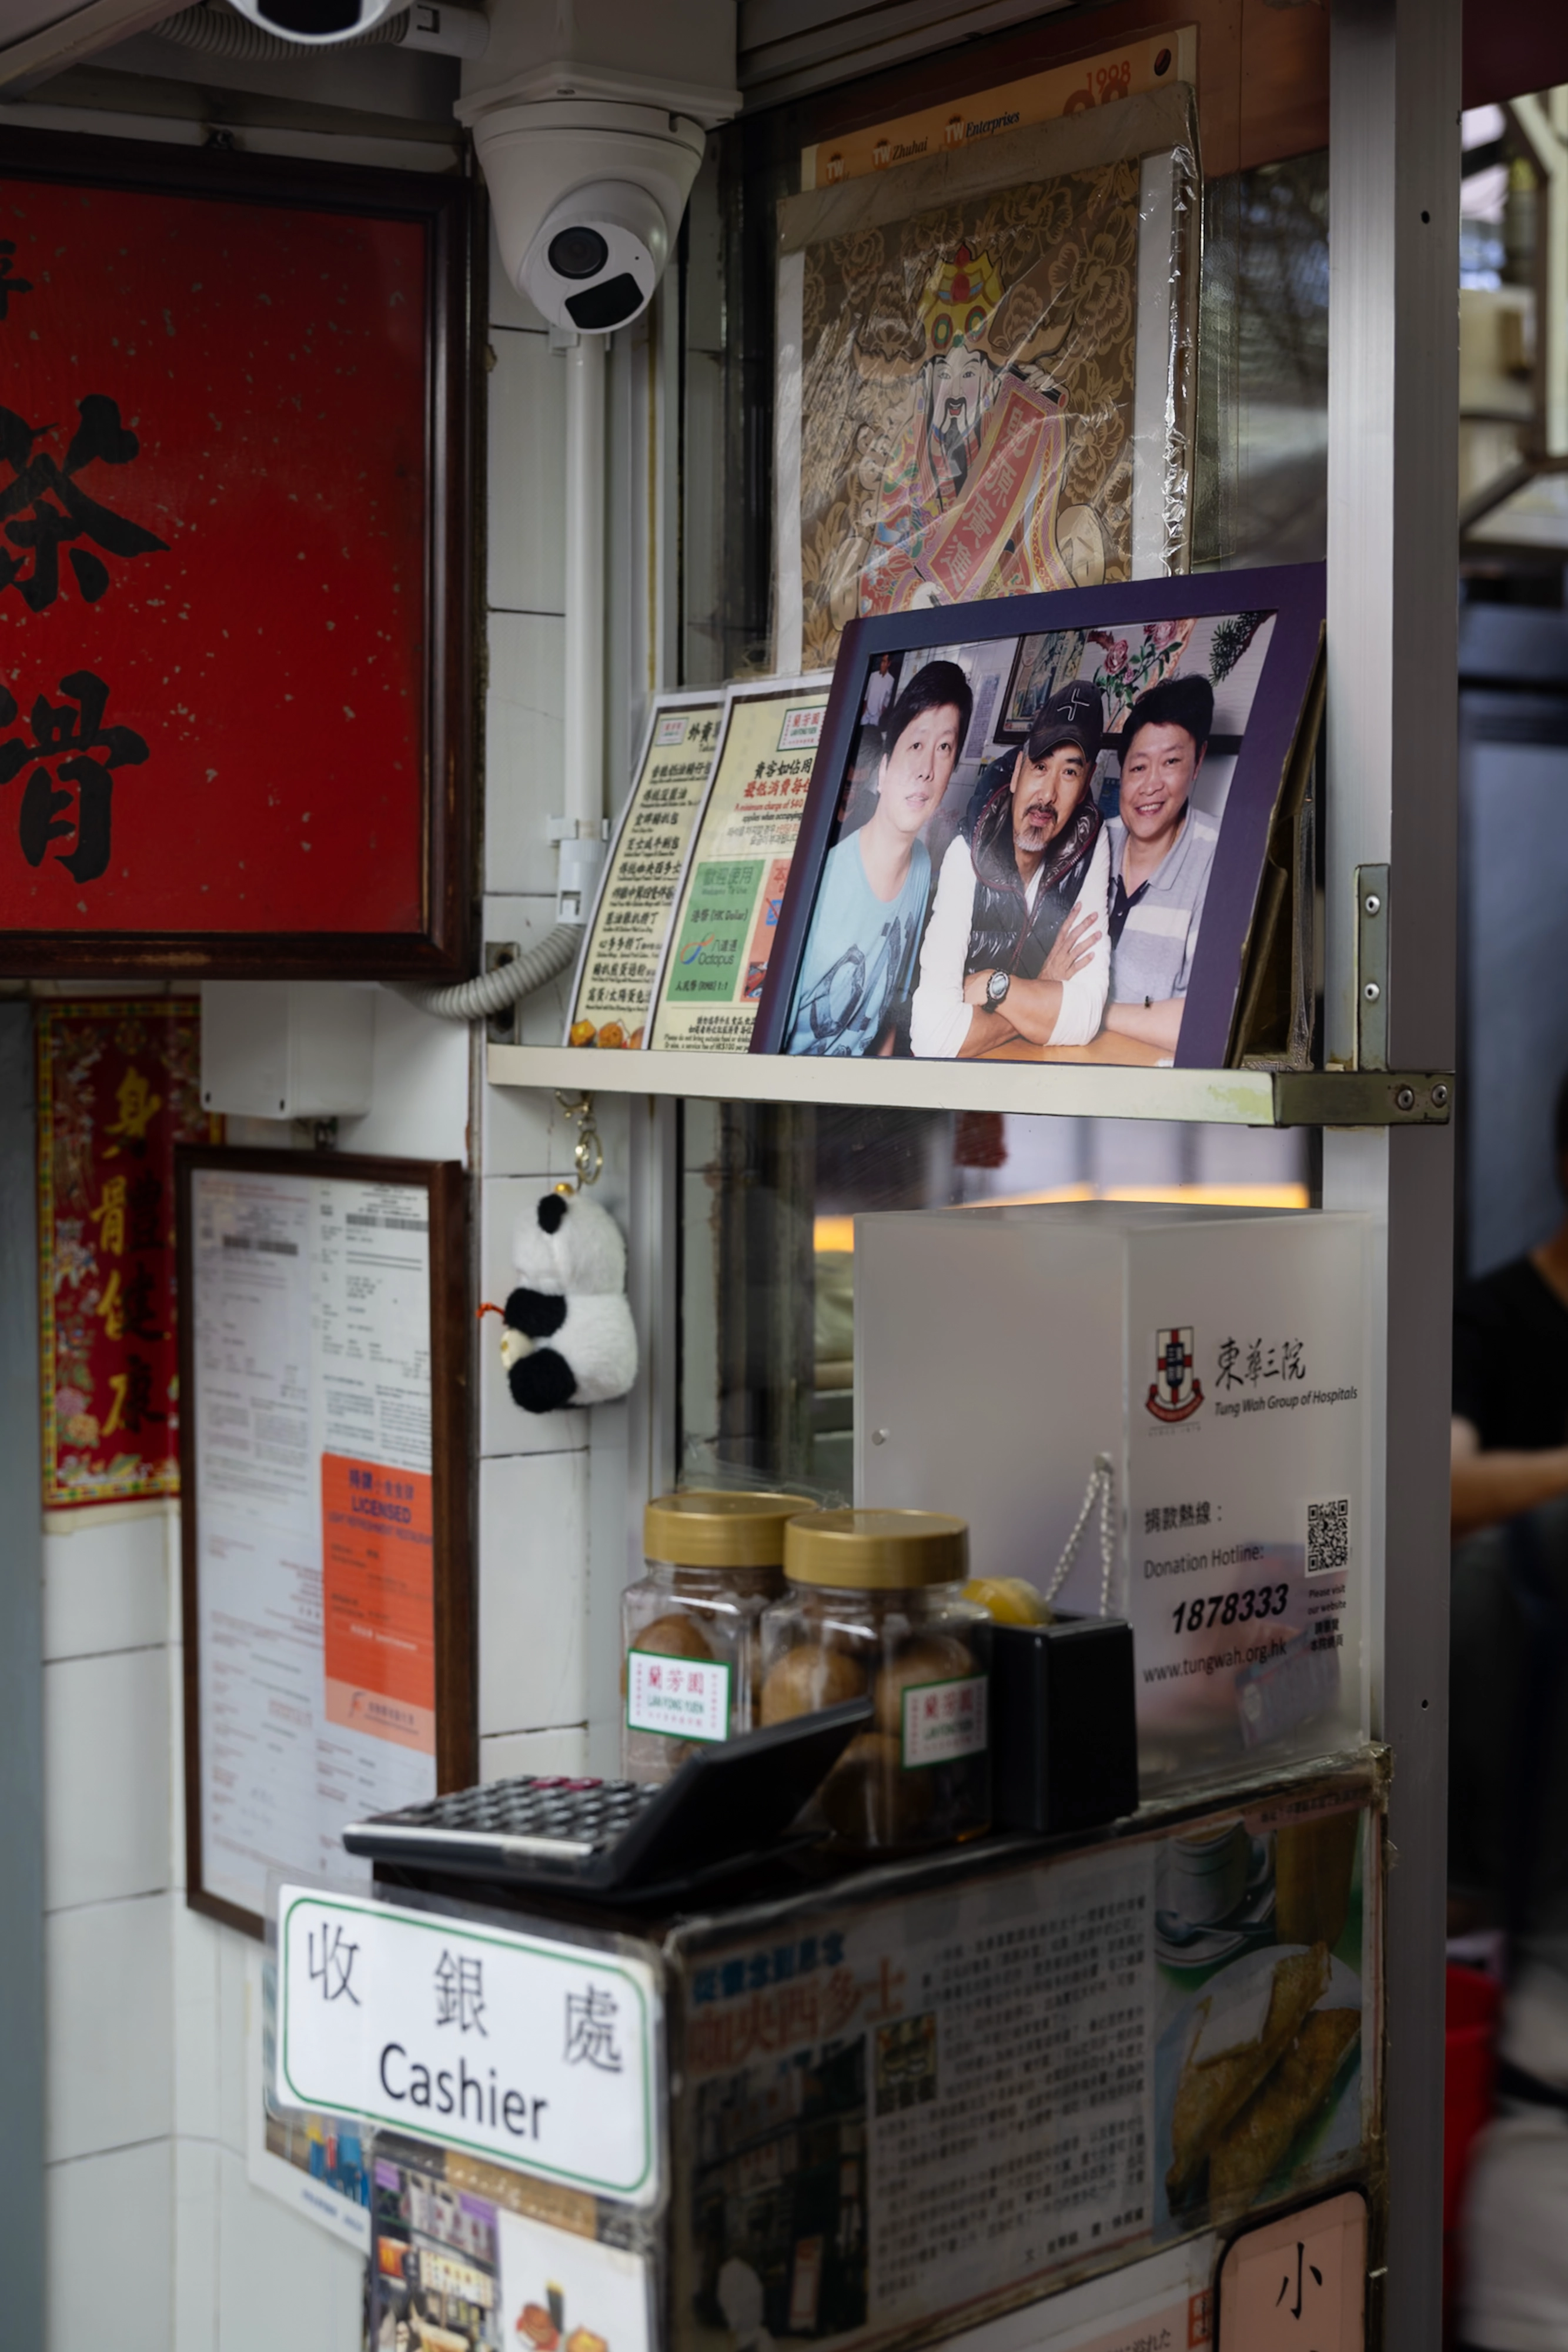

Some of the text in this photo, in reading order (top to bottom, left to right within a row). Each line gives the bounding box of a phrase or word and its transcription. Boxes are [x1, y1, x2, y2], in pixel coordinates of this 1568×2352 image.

[1087, 61, 1131, 91] 1998
[965, 111, 1020, 139] Enterprises
[891, 136, 928, 161] Zhuhai
[698, 952, 735, 967] Octopus
[1215, 1336, 1306, 1391] 東華三院
[1215, 1385, 1358, 1418] Tung Wah Group of Hospitals
[353, 1496, 411, 1524] LICENSED
[1144, 1545, 1265, 1579] Donation Hotline:
[1307, 1600, 1347, 1615] our website
[1308, 1584, 1346, 1599] Please visit
[1172, 1583, 1289, 1634] 1878333
[1142, 1639, 1288, 1683] www.tungwah.org.hk
[307, 1921, 623, 2074] 收銀處
[379, 2041, 549, 2140] Cashier
[1276, 2241, 1323, 2320] 小
